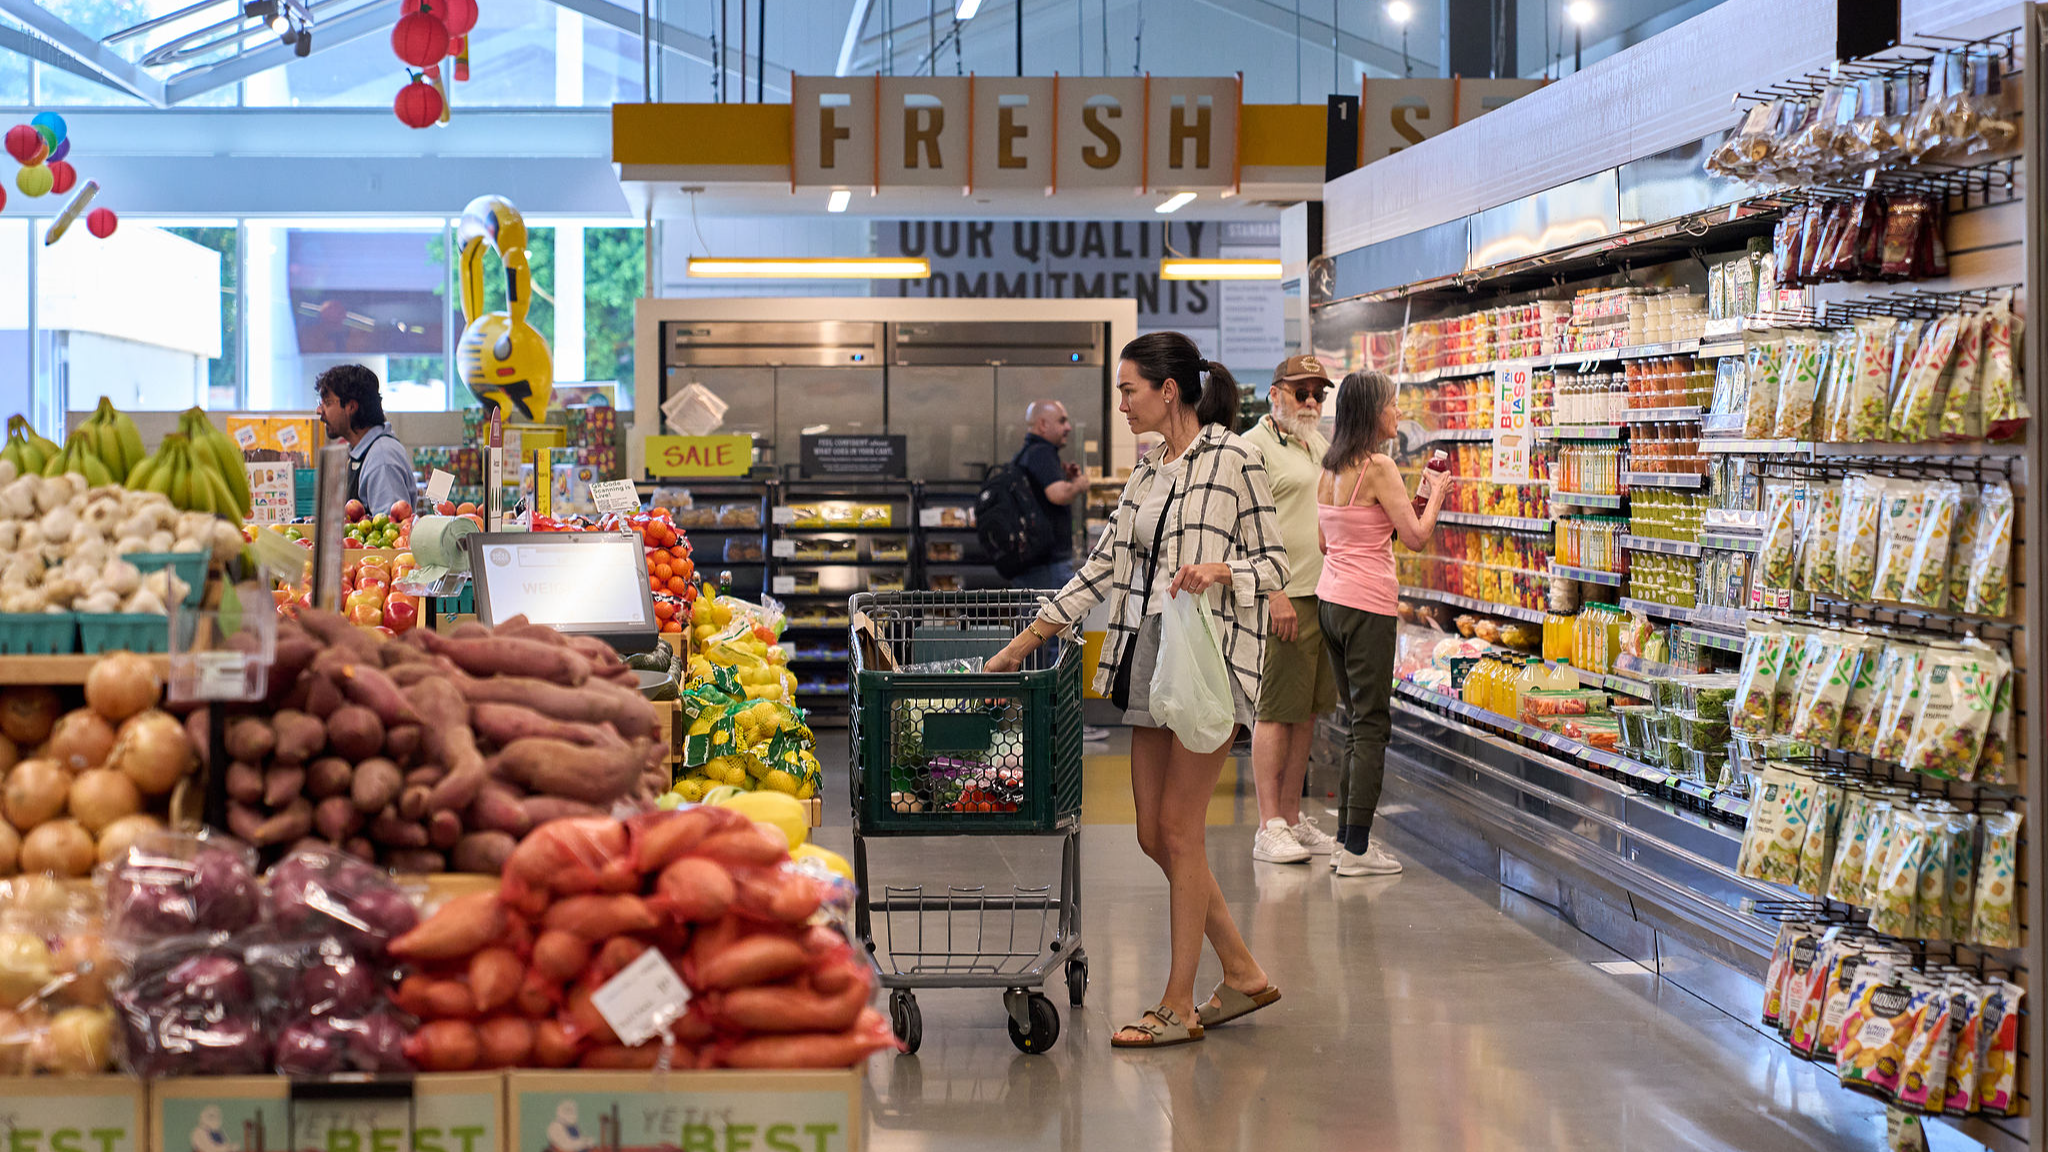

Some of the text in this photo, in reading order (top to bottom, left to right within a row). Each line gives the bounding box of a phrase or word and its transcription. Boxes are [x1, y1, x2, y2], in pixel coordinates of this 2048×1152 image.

[1338, 101, 1347, 120] 1
[819, 93, 1213, 170] FRESH
[900, 221, 994, 259] OUR
[1501, 384, 1514, 429] BEST
[1513, 371, 1526, 429] CLASS
[663, 443, 734, 468] SALE
[681, 1123, 838, 1152] BEST
